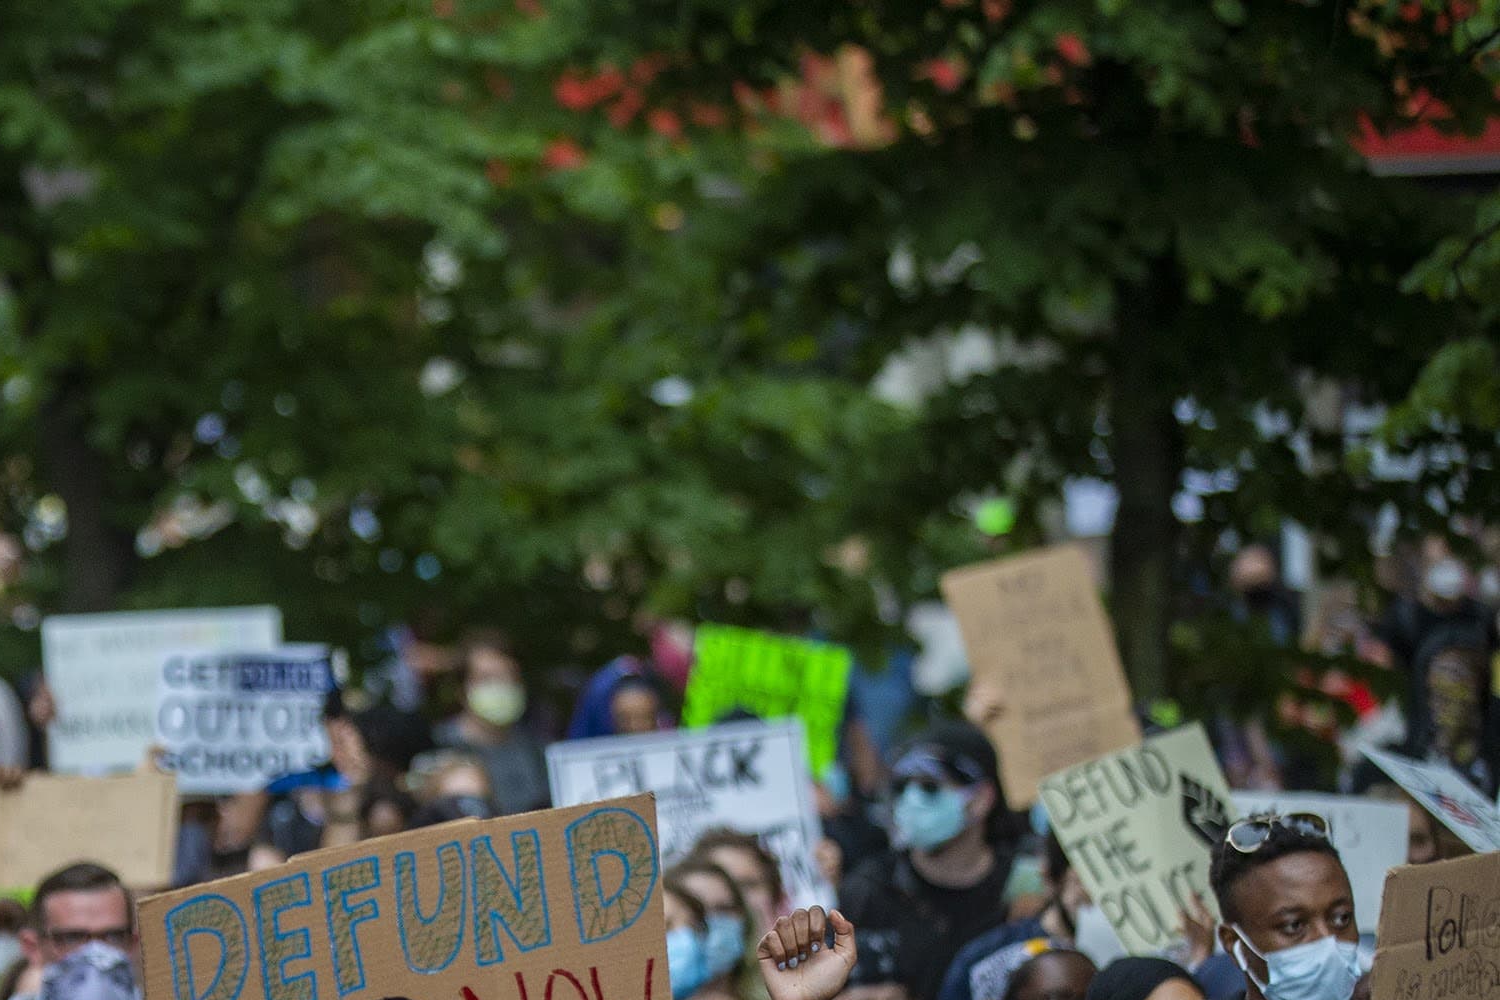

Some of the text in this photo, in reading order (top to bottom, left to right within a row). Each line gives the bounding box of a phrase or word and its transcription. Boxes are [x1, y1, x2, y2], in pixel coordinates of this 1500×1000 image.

[163, 656, 236, 691] GET
[158, 697, 257, 742] OUT
[594, 738, 763, 798] BLACK
[1041, 749, 1173, 829] DEFUND
[1064, 818, 1152, 887] THE
